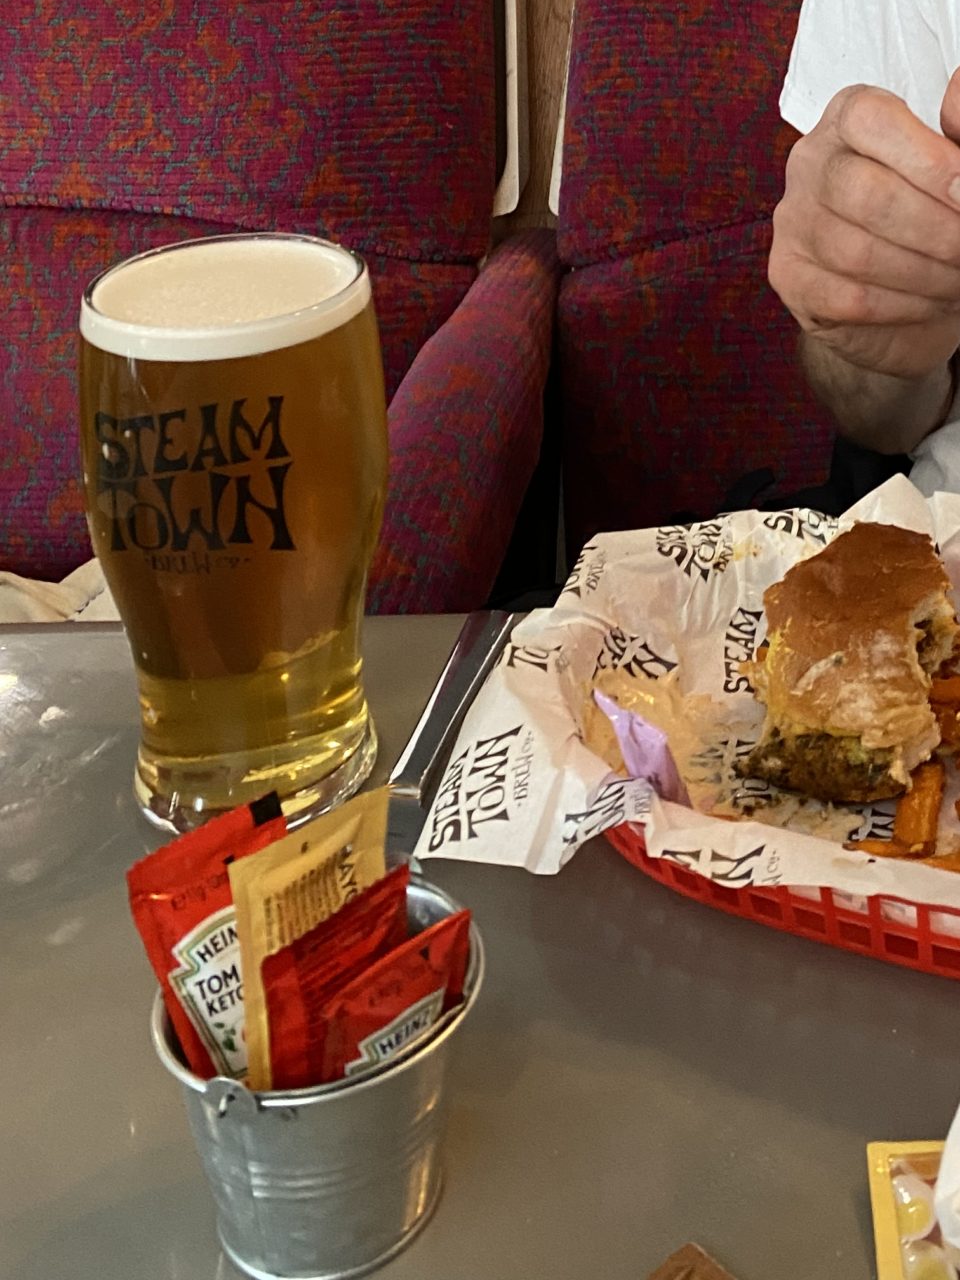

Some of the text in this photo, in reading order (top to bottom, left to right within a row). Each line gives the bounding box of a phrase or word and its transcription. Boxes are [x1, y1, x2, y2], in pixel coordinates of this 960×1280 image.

[95, 395, 291, 480] STEAM
[97, 462, 297, 551] TOWN
[723, 607, 764, 694] STEAM
[428, 744, 471, 853] STEAM
[466, 724, 524, 840] TOWN
[195, 965, 240, 1000] TOM
